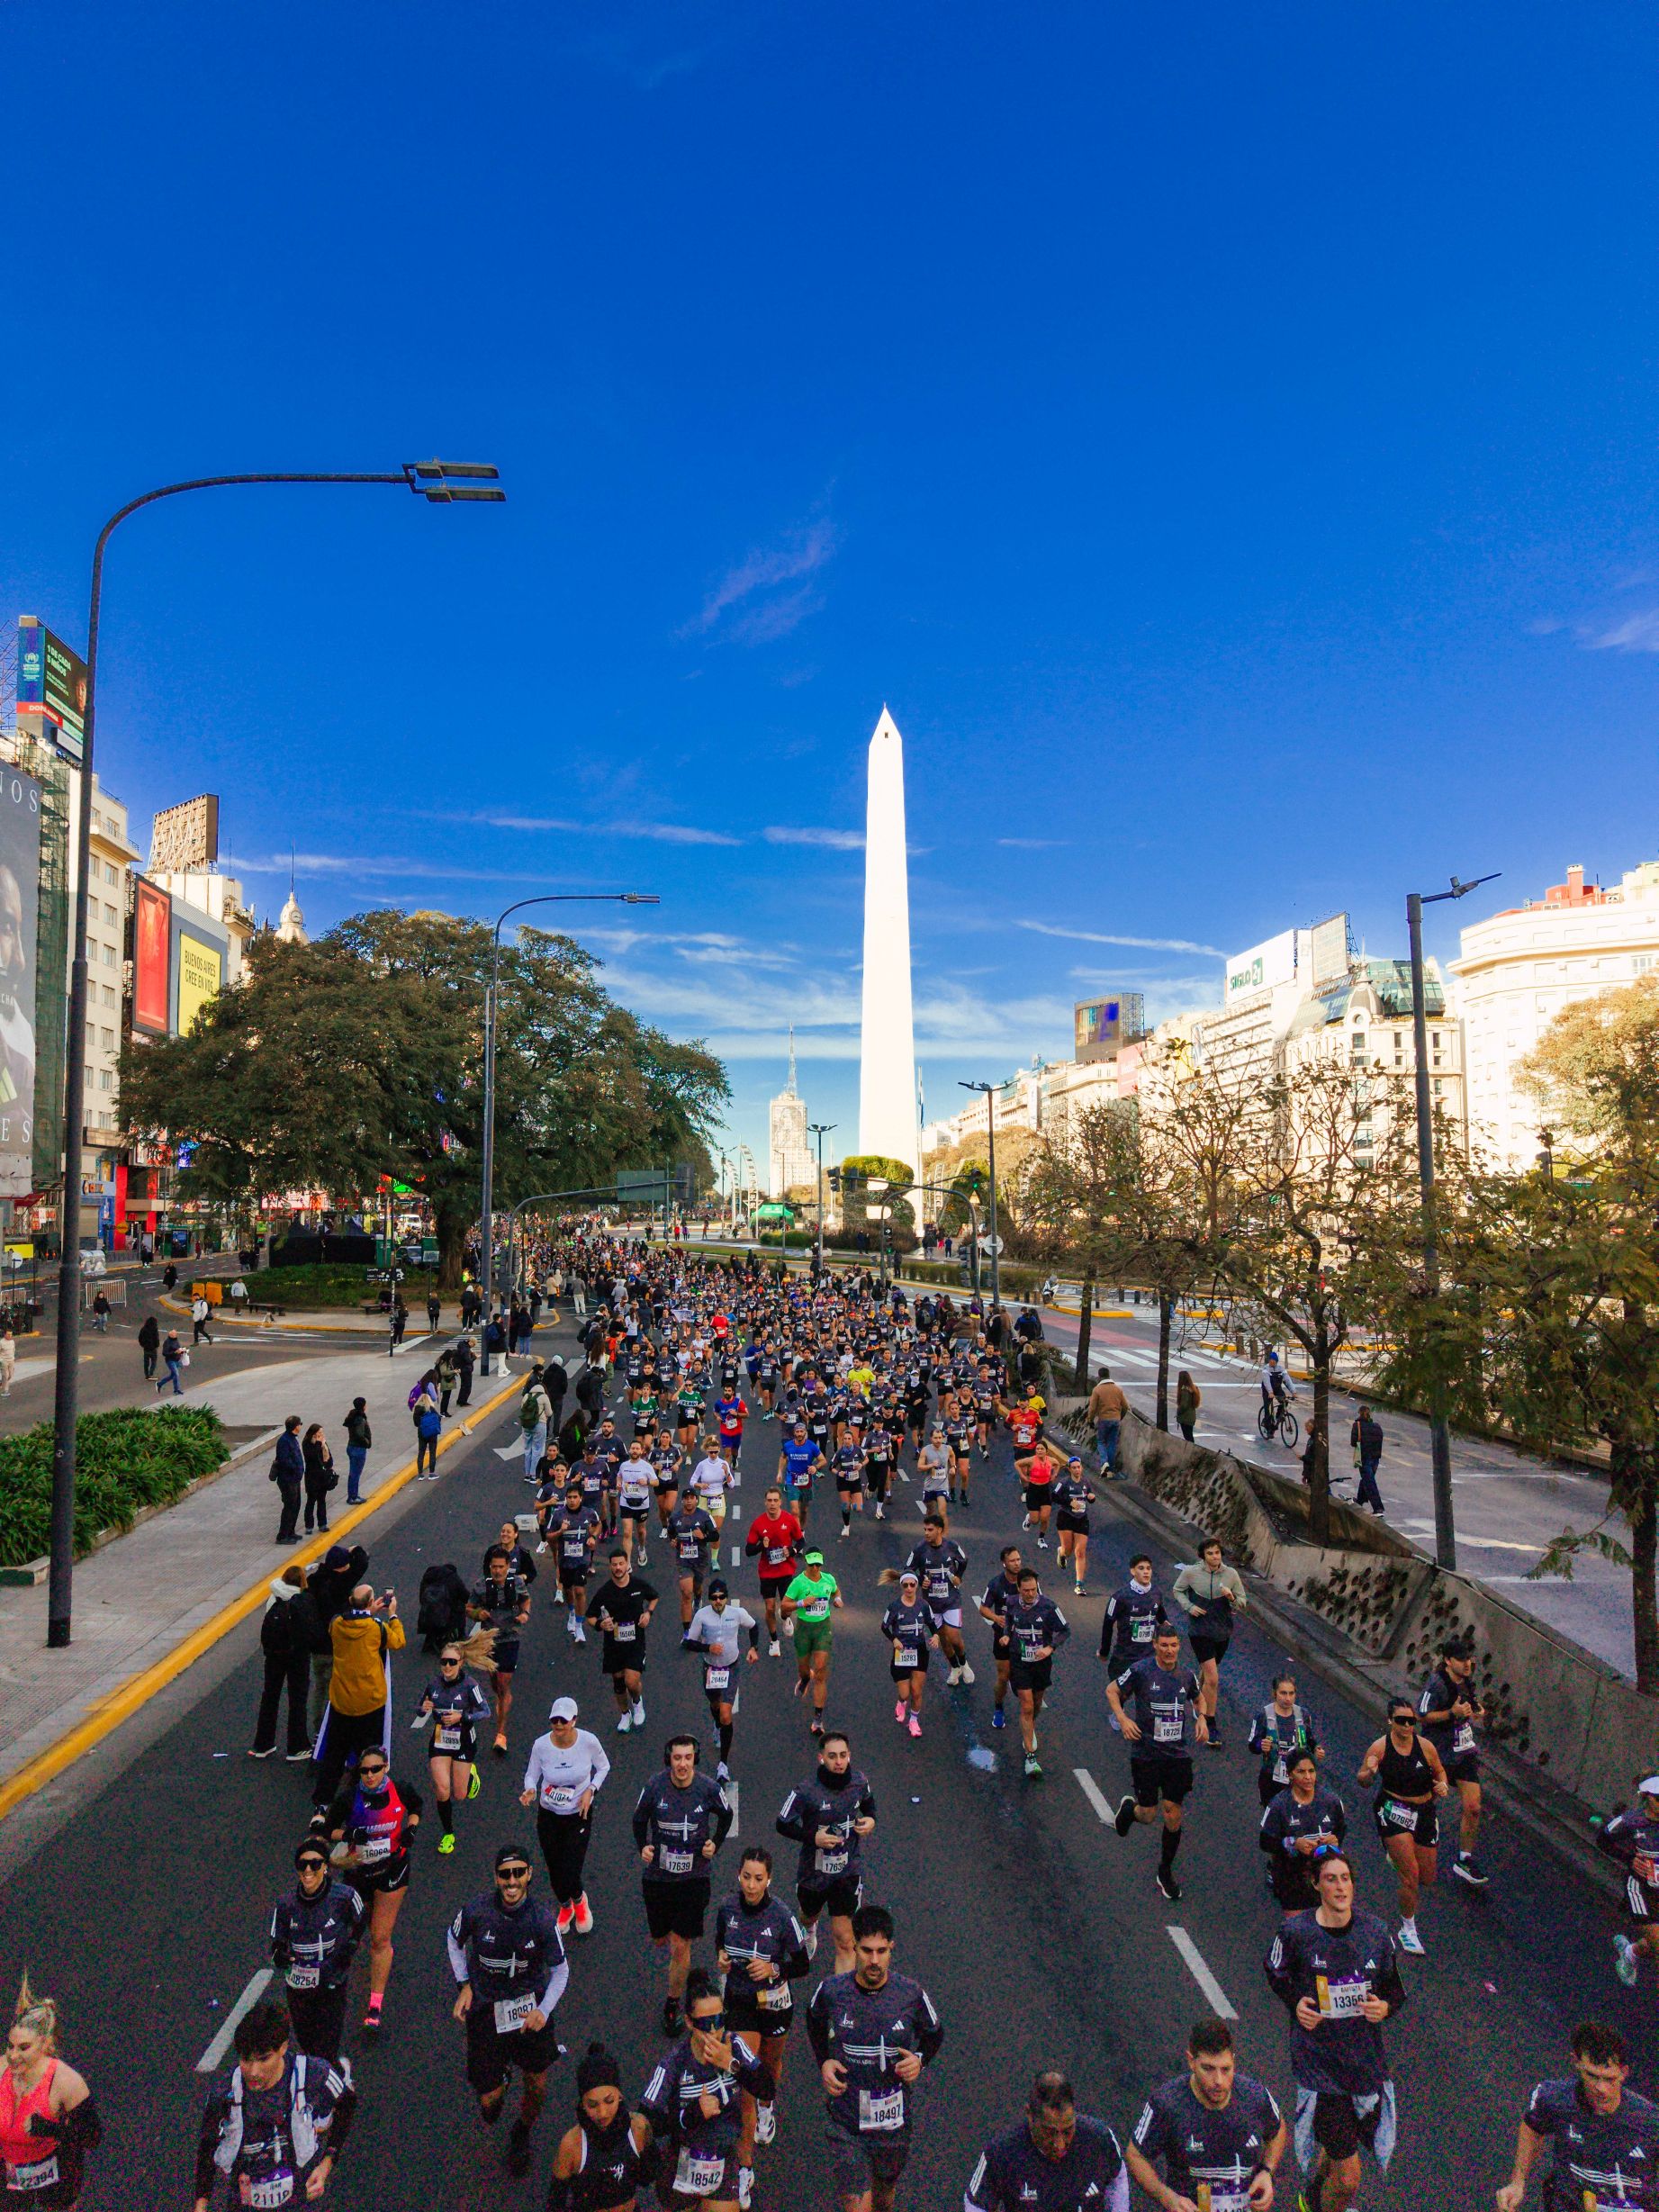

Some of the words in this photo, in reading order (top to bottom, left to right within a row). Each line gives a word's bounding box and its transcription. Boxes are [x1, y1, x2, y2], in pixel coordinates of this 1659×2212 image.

[58, 654, 72, 672] CADA
[185, 950, 203, 971] BUENOS
[203, 960, 216, 978] AIRES
[185, 969, 197, 987] CREE
[198, 975, 204, 989] EN
[1230, 970, 1251, 991] SIGLO
[668, 1861, 691, 1872] 17639
[874, 2103, 901, 2123] 18497
[690, 2171, 722, 2187] 18542
